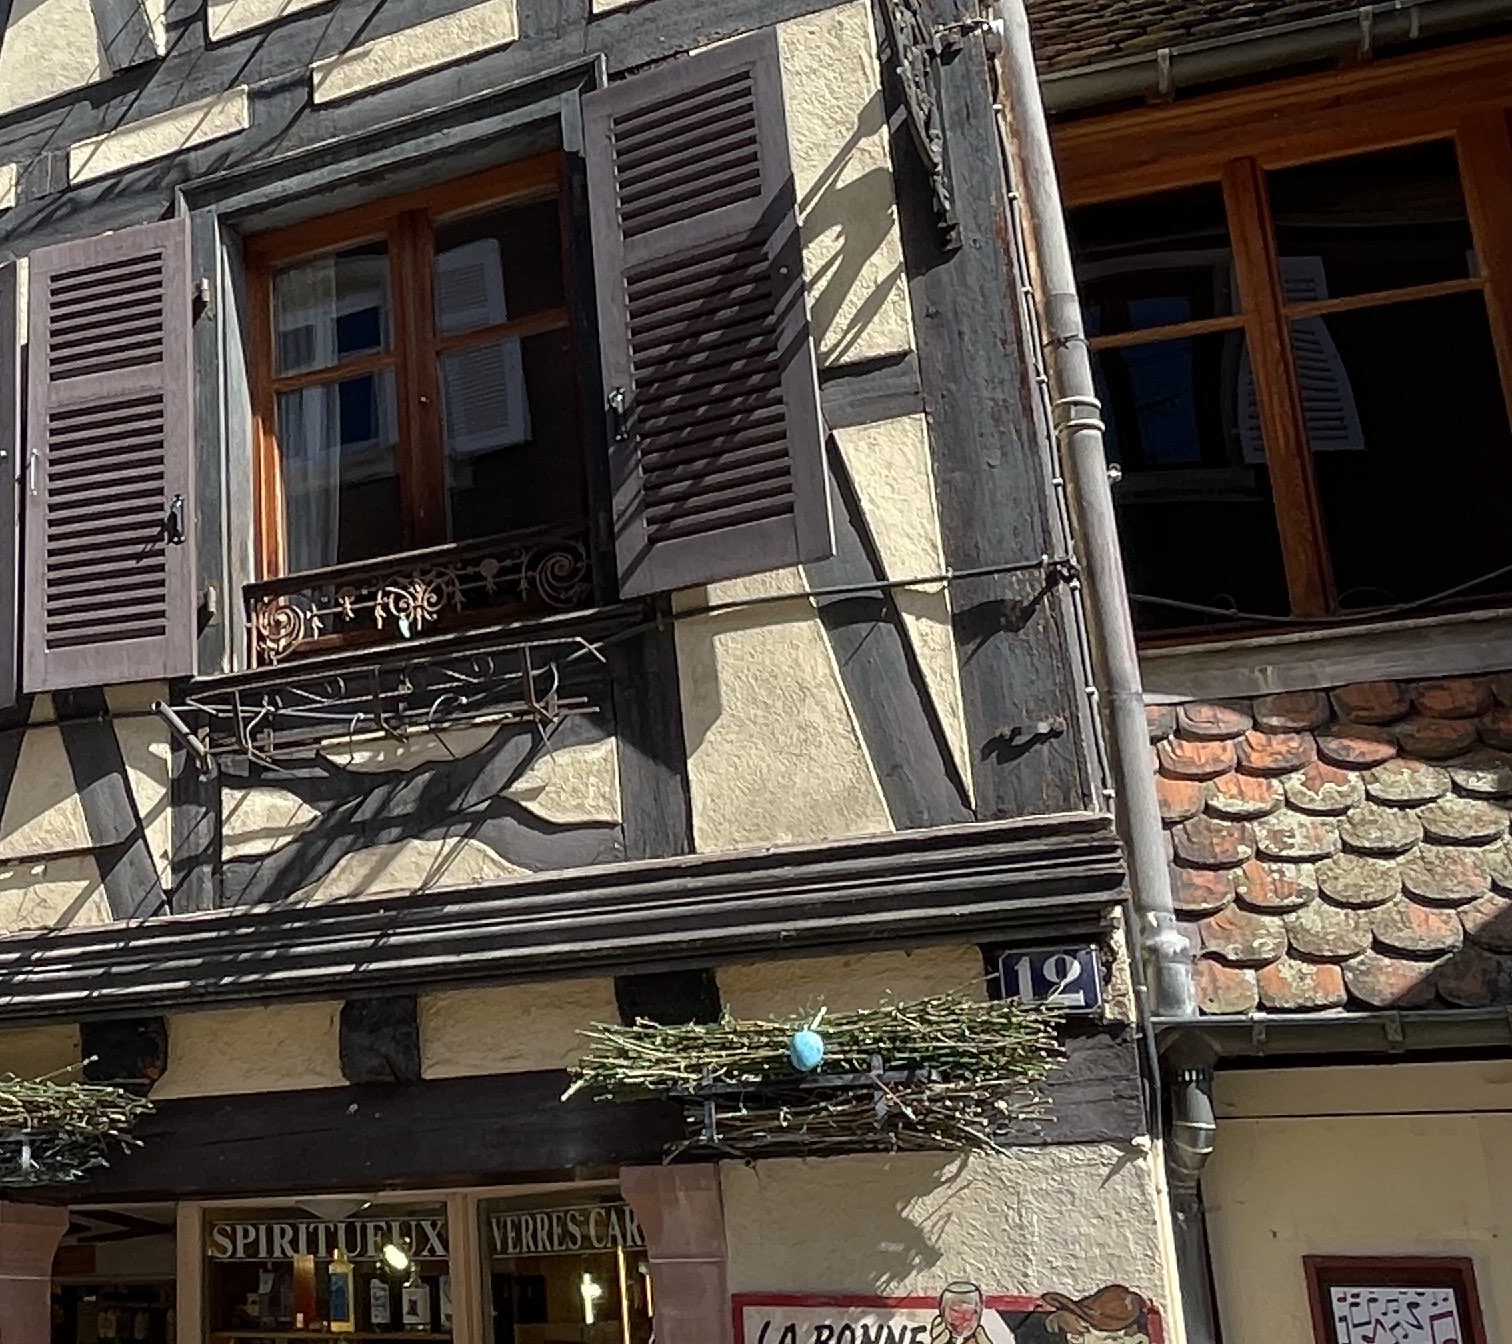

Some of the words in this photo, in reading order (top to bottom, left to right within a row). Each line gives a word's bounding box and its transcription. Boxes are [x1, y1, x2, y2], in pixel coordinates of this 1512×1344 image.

[1014, 955, 1085, 1006] 12
[212, 1220, 447, 1258] SPIRITUEUX
[491, 1210, 582, 1254] VERRES
